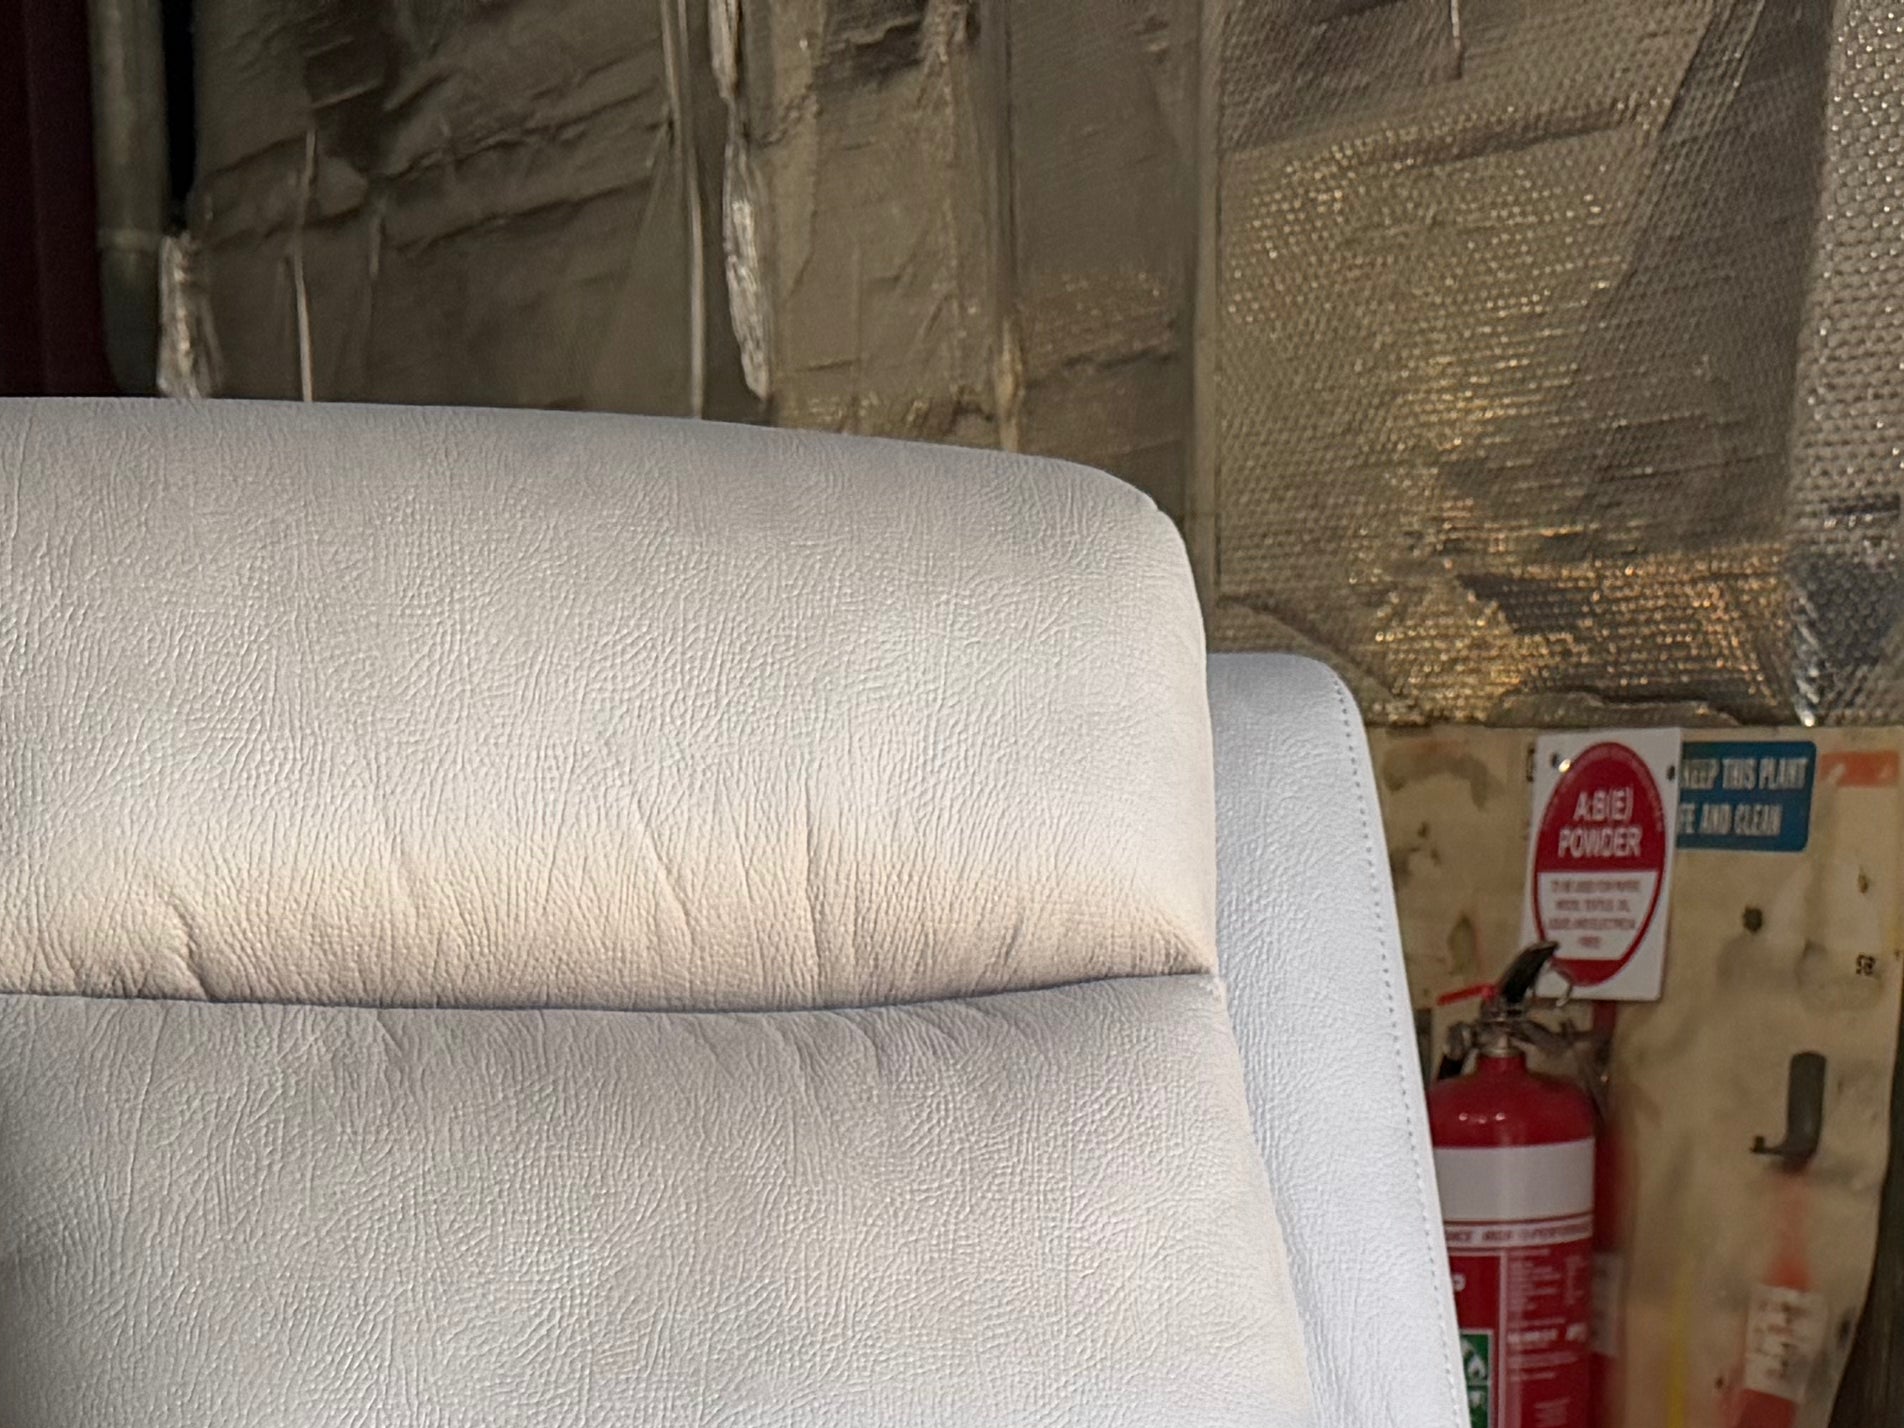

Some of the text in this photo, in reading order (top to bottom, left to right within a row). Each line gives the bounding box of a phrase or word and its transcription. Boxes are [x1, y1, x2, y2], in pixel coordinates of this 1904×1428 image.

[1722, 757, 1756, 790] THIS
[1758, 756, 1809, 790] PLANT
[1699, 802, 1733, 835] AND
[1734, 802, 1783, 837] CLEAN
[1558, 826, 1643, 859] POWDER
